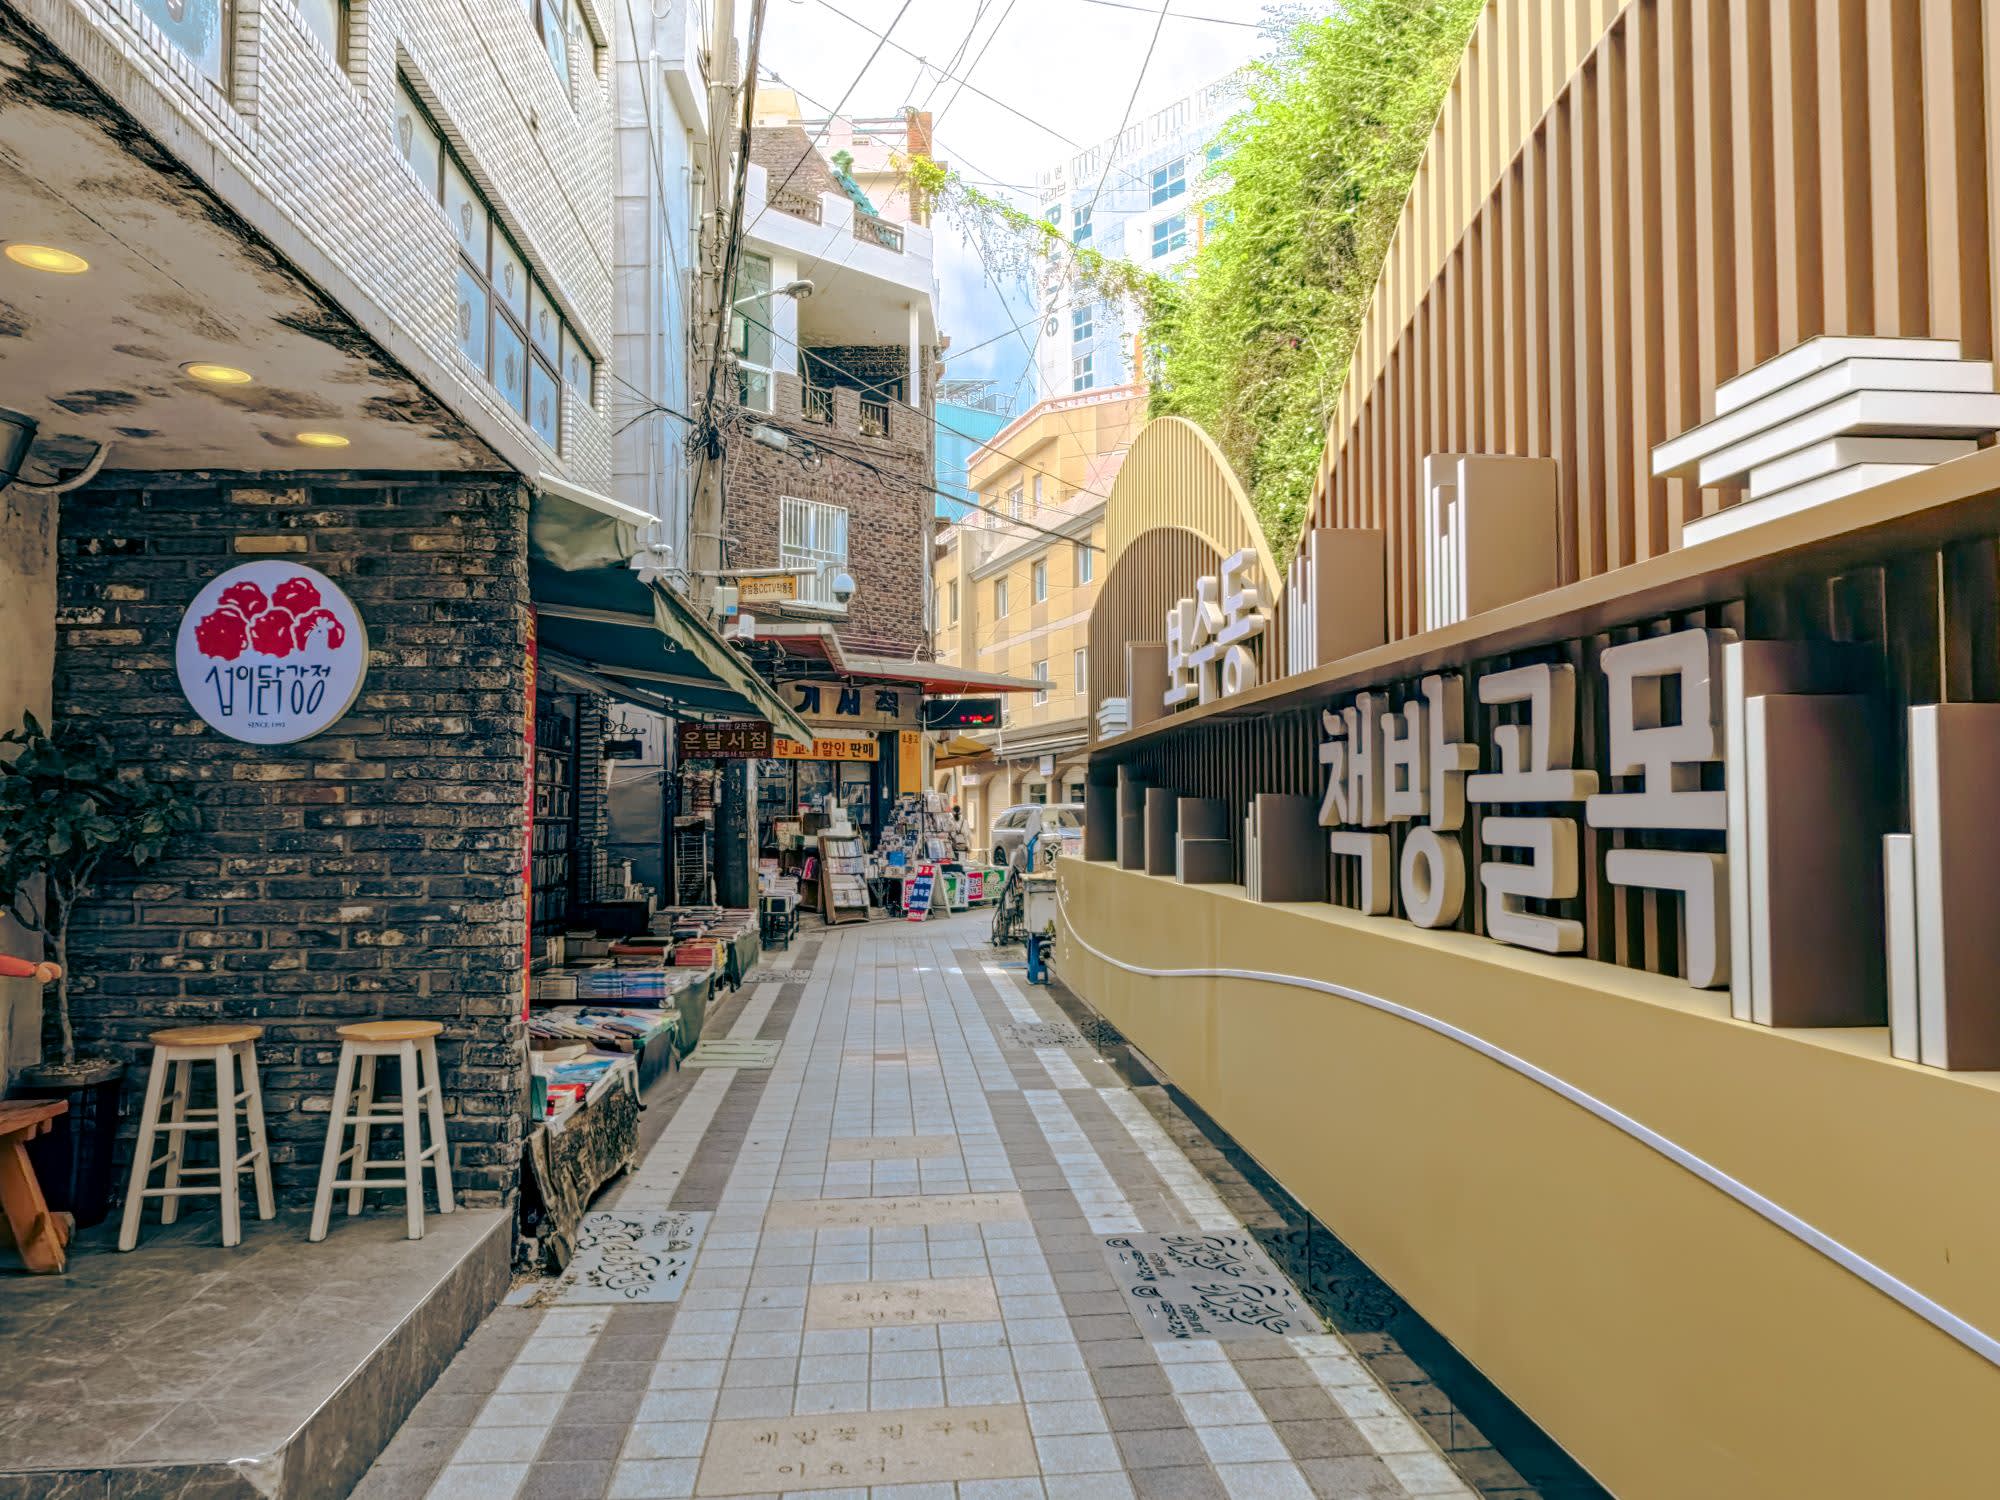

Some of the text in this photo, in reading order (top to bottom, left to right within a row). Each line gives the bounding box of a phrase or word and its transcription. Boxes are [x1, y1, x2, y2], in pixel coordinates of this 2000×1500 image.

[1163, 547, 1265, 707] 보수동
[682, 731, 767, 750] 온달서점
[821, 741, 846, 757] 할인
[850, 742, 874, 758] 판매
[1318, 627, 1730, 990] 책방골목
